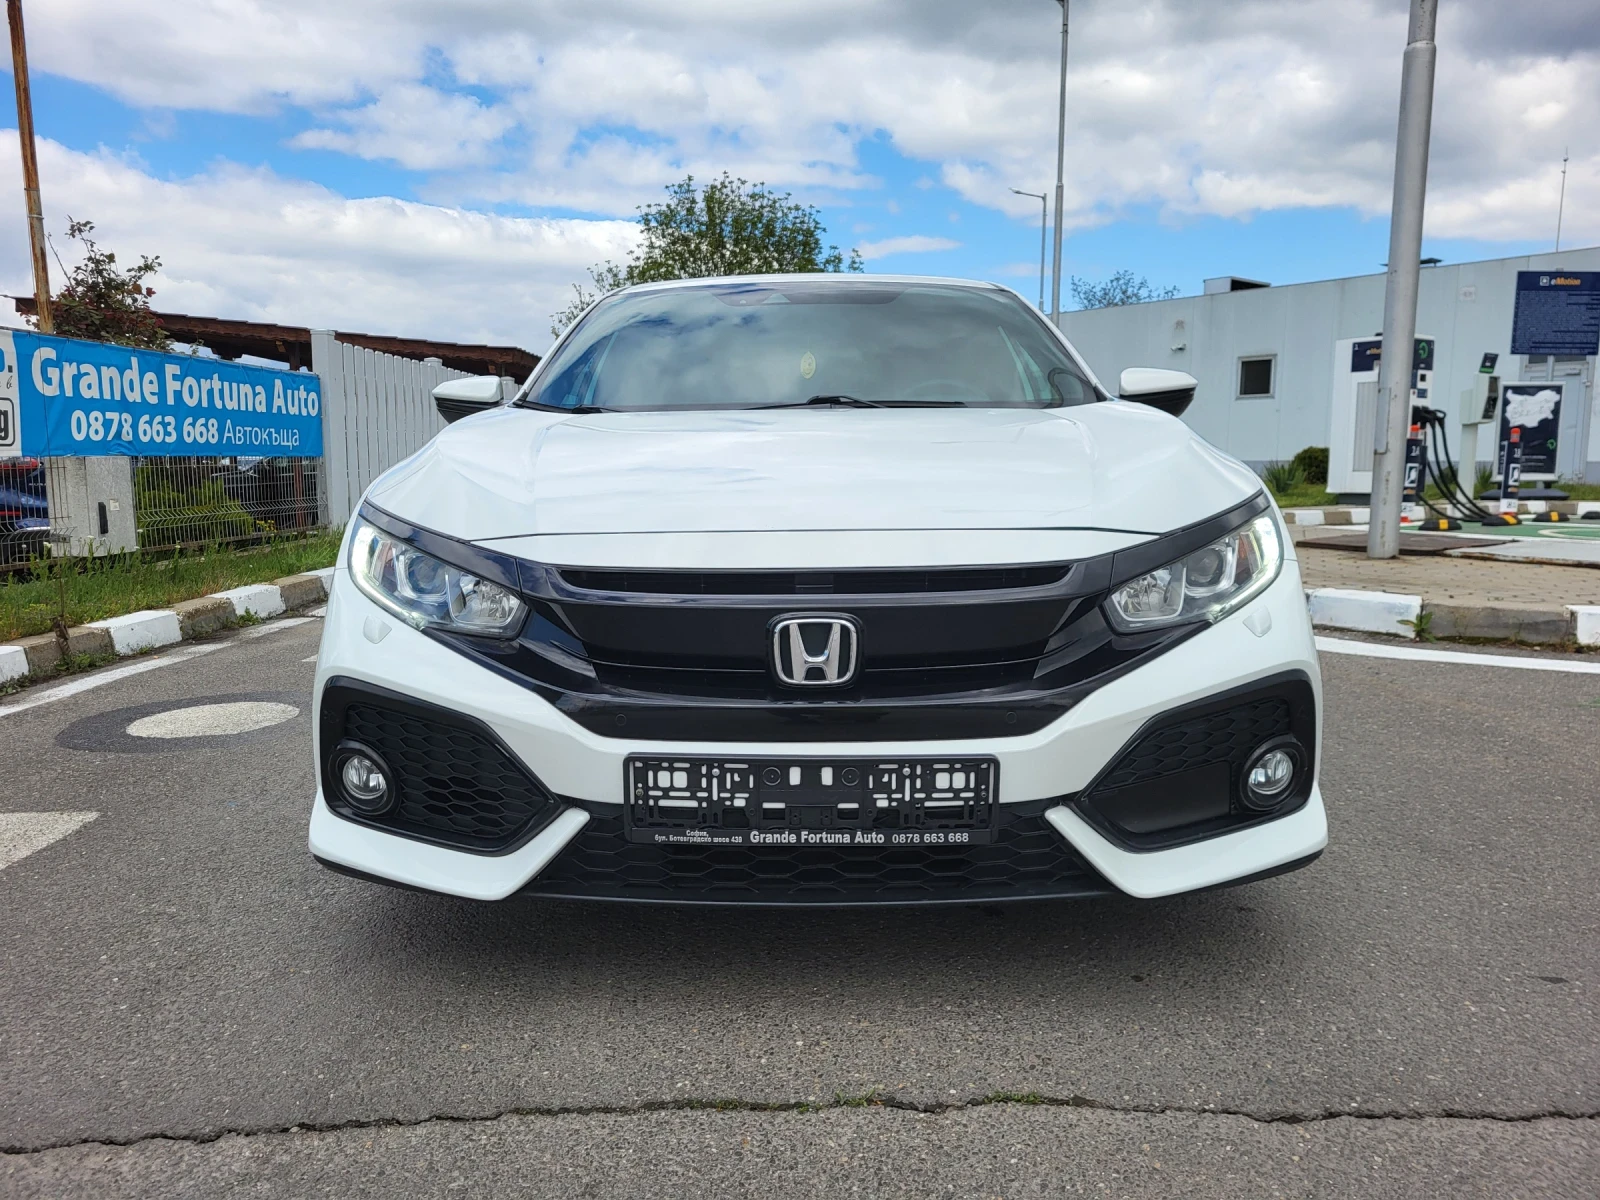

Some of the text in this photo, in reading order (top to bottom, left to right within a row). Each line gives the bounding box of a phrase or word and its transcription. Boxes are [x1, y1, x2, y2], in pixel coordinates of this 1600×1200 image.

[31, 346, 319, 417] Grande Fortuna Auto
[70, 409, 300, 450] 0878 663 668 Автокъща
[749, 830, 969, 844] Grande Fortuna Auto 0878 663 668
